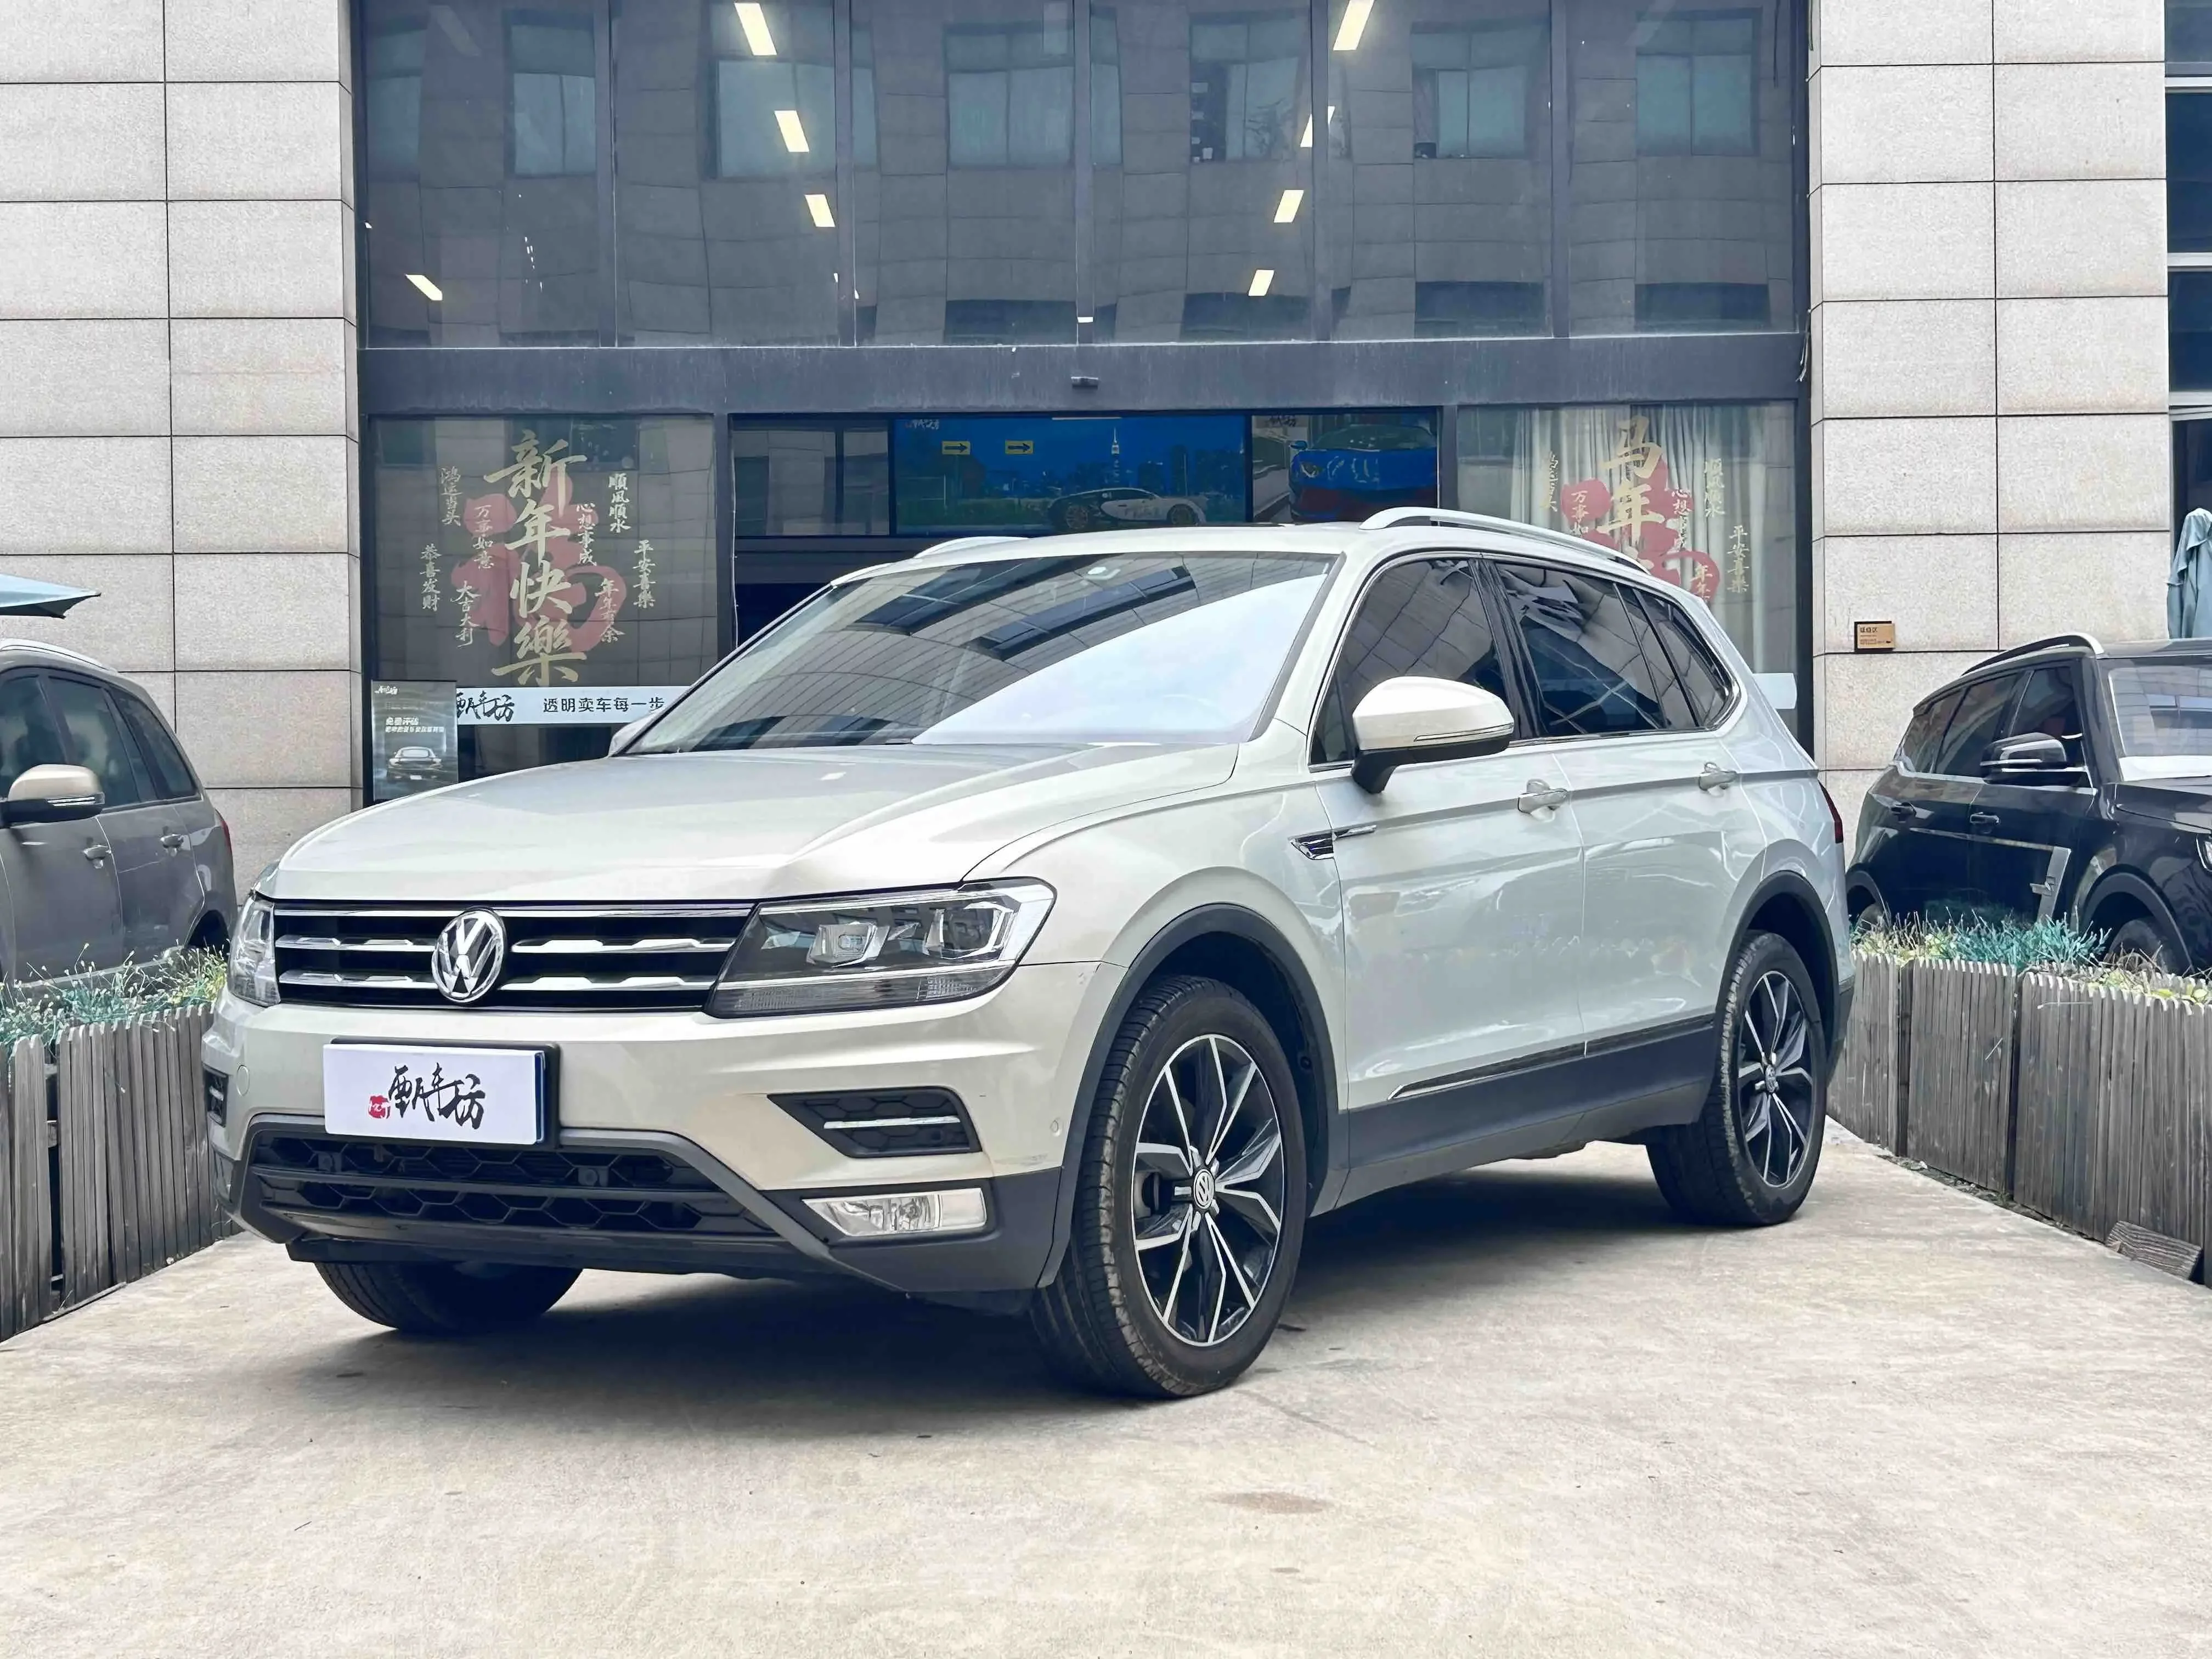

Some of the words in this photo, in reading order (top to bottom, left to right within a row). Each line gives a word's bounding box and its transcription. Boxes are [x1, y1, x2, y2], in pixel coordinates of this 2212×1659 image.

[1595, 415, 1666, 571] 马年
[472, 504, 494, 569] 万事如意
[483, 429, 588, 686] 新年快樂
[450, 580, 482, 648] 大吉大利
[543, 696, 665, 713] 透明卖车每一步
